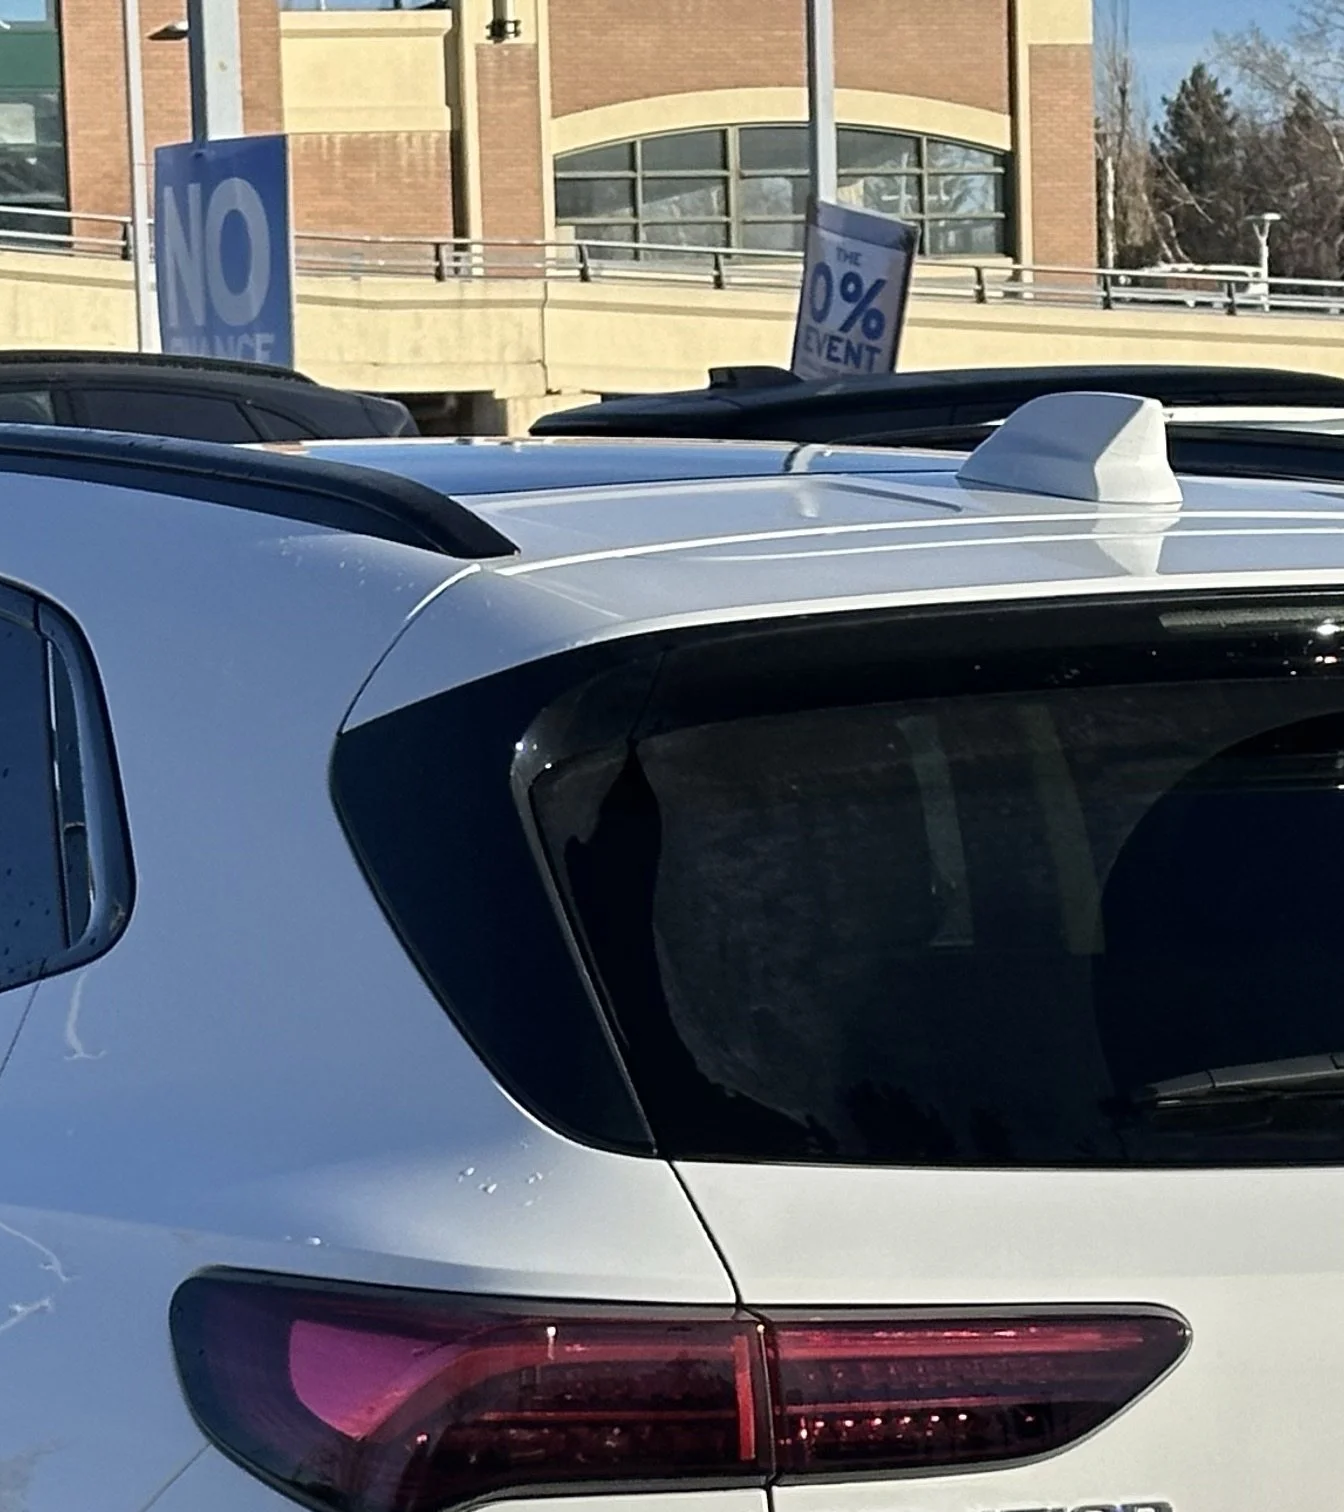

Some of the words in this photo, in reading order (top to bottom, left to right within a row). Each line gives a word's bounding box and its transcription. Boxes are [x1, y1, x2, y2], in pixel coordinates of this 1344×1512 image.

[163, 177, 270, 326] NO
[836, 247, 863, 267] THE
[810, 261, 887, 340] 0%
[802, 324, 884, 373] EVENT
